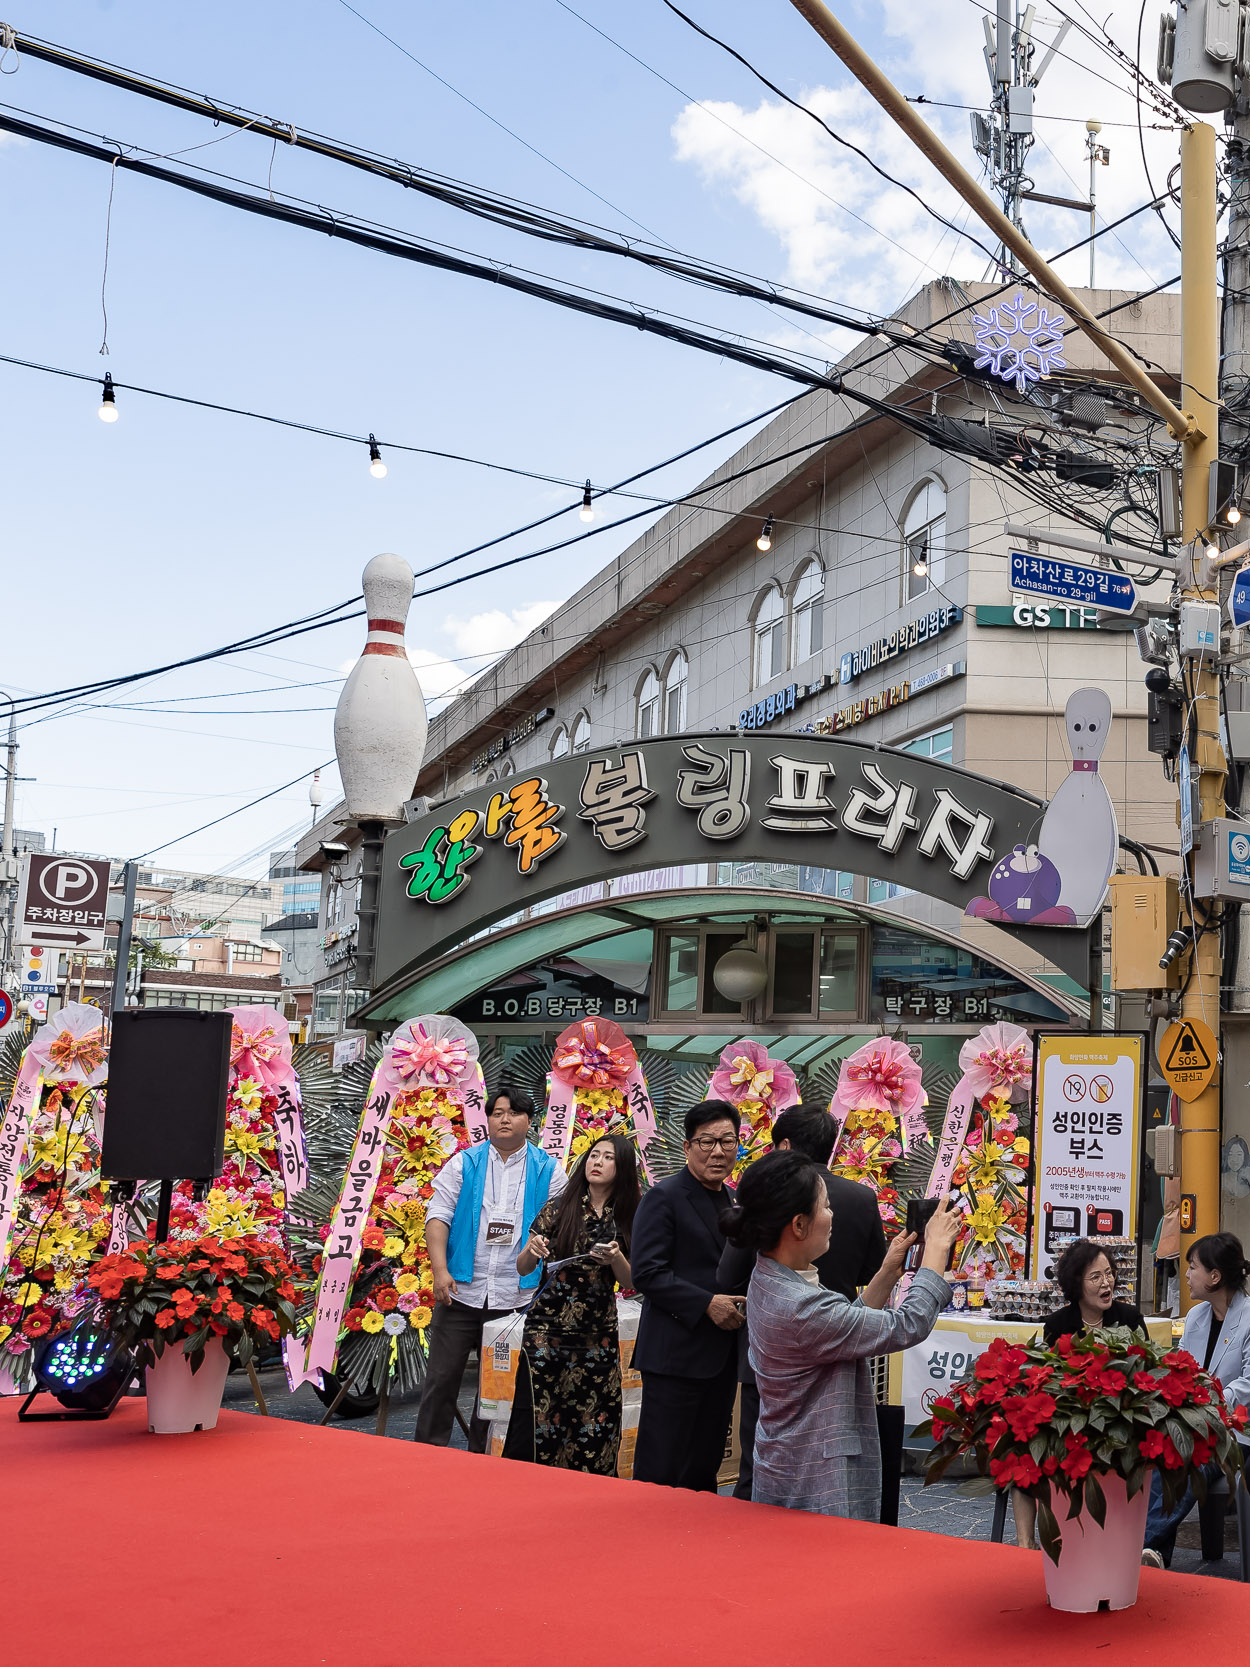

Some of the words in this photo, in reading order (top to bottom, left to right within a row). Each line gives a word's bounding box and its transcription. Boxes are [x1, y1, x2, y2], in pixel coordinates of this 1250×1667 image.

[1013, 557, 1109, 594] 아차산로29길
[1014, 576, 1068, 595] Achasan-ro
[1070, 587, 1096, 602] 29-gil
[1236, 590, 1246, 605] 49
[940, 607, 954, 629] 3F
[1013, 604, 1051, 627] GS
[398, 776, 567, 904] 한아름
[577, 744, 996, 882] 볼링프라자
[55, 865, 88, 898] P
[26, 906, 104, 925] 주차장입구
[482, 999, 541, 1016] B.O.B
[548, 997, 602, 1017] 당구장
[614, 998, 638, 1015] B1
[885, 996, 952, 1016] 탁구장
[965, 997, 989, 1014] B1
[1178, 1056, 1198, 1066] SOS
[1173, 1072, 1204, 1083] 긴급신고
[1052, 1111, 1123, 1136] 성인인증
[940, 1104, 965, 1168] 신한은행
[1068, 1137, 1104, 1160] 부스
[328, 1091, 391, 1260] 새마을금고
[1116, 1172, 1127, 1180] 가능
[1049, 1183, 1069, 1191] 성인인증
[490, 1227, 513, 1235] STAFF
